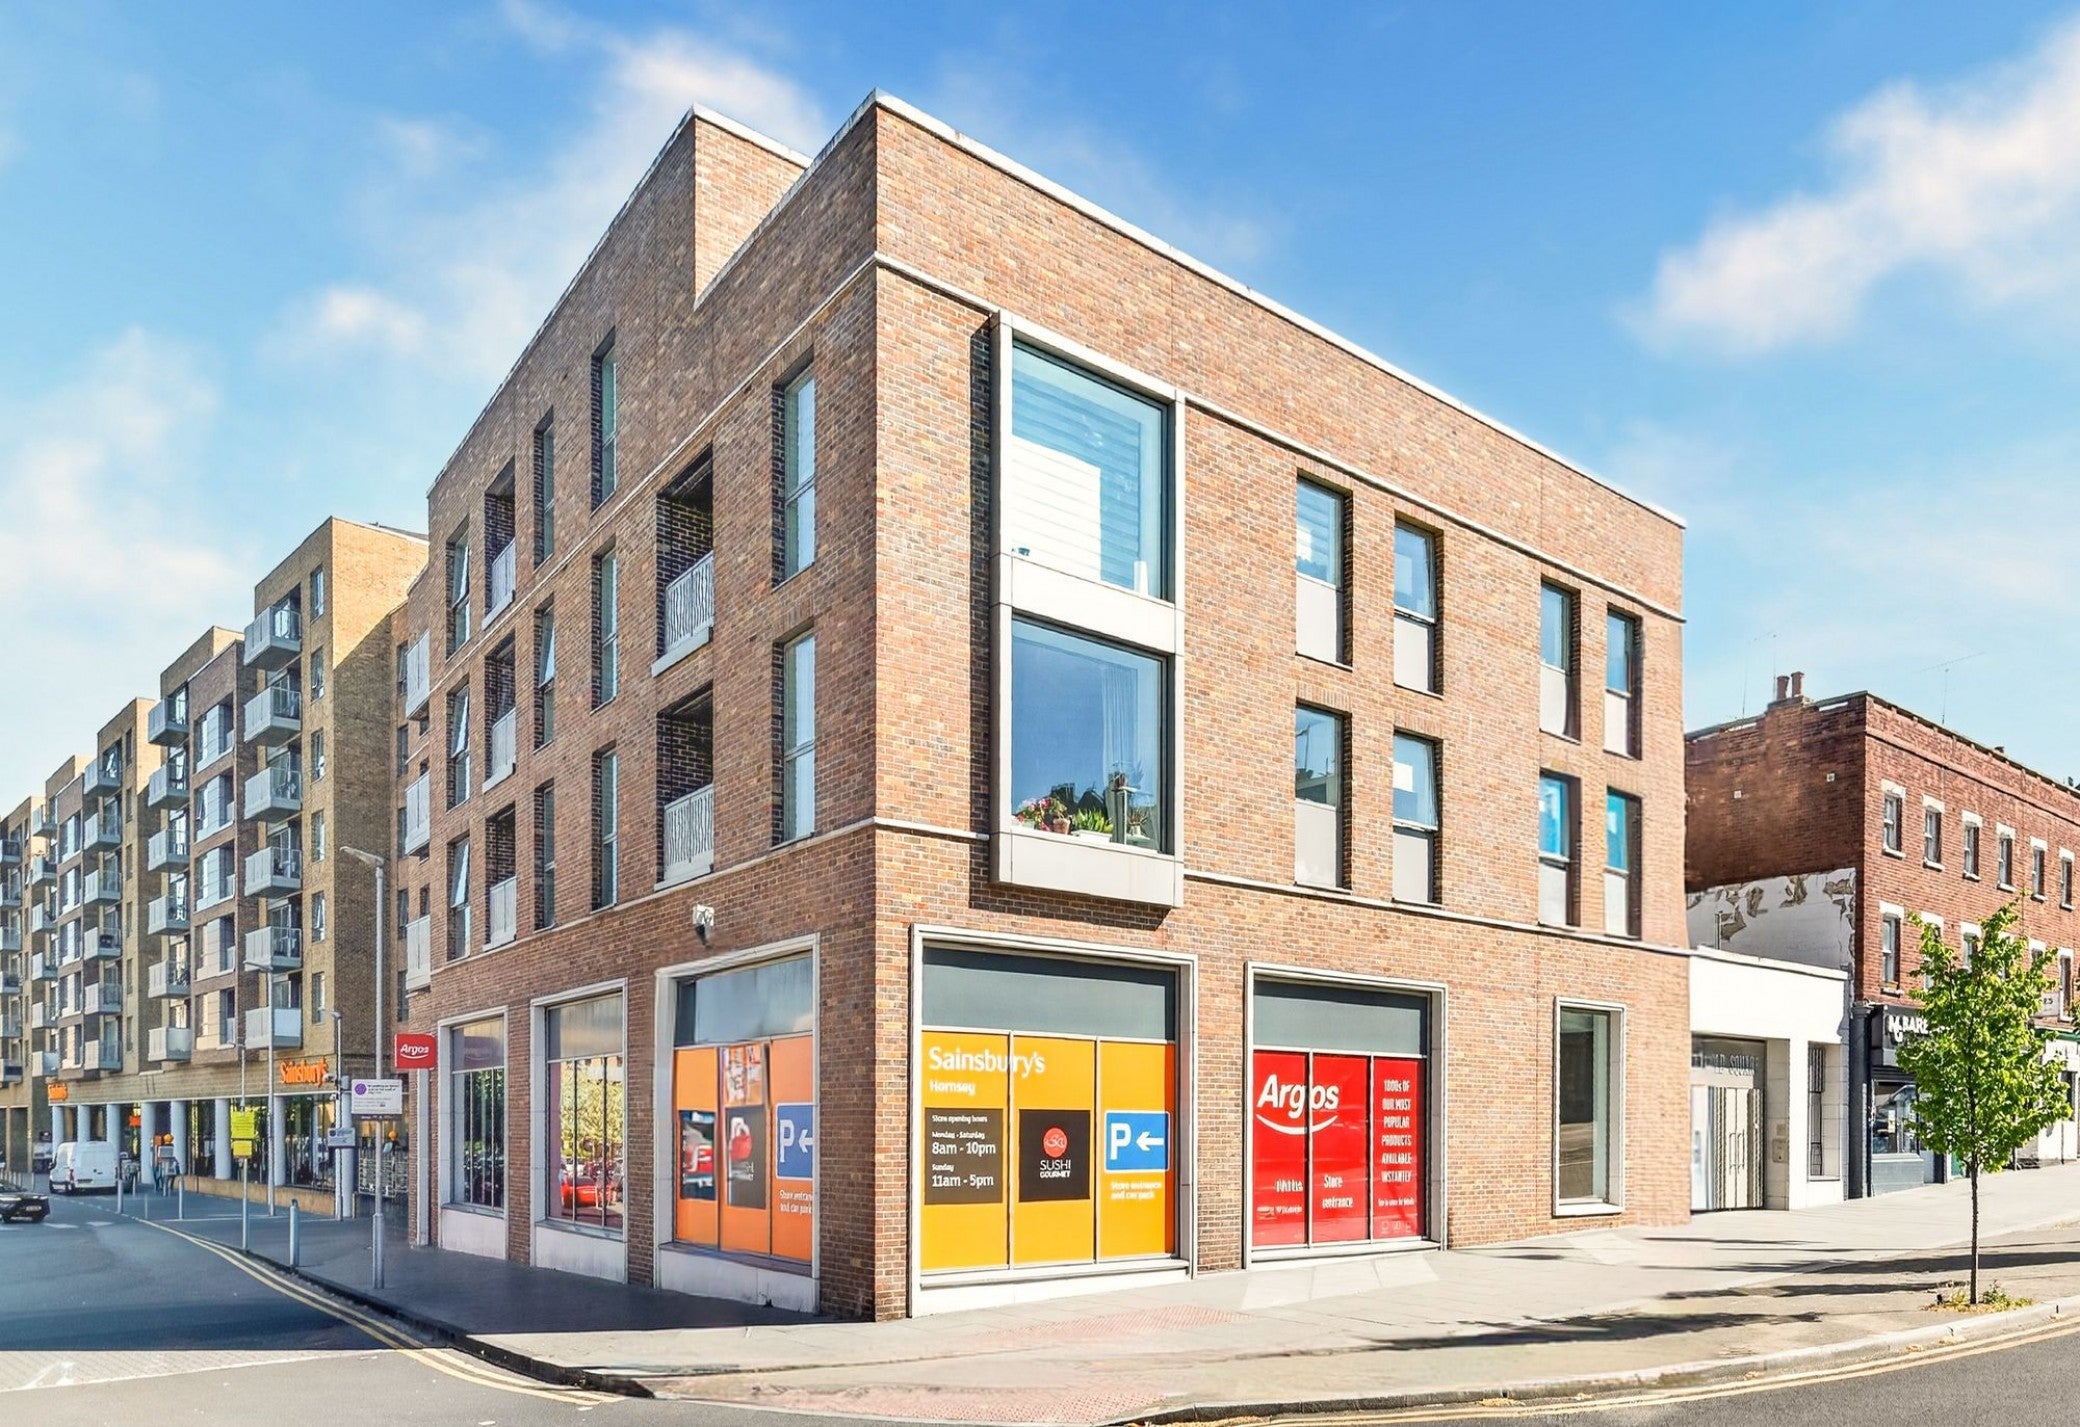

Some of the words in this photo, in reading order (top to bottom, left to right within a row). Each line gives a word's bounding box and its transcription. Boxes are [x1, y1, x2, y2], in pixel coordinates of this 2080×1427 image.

[400, 1043, 429, 1056] Argos
[928, 1046, 1046, 1079] Sainsbury's
[929, 1080, 976, 1096] Hornsey
[1257, 1074, 1340, 1119] Argos
[1110, 1122, 1132, 1160] P
[931, 1141, 958, 1155] 8am
[965, 1141, 996, 1157] 10pm
[931, 1163, 955, 1172] Sunday
[1040, 1160, 1072, 1171] SUSHI
[931, 1174, 961, 1187] 11am
[969, 1174, 994, 1189] 5pm
[1323, 1174, 1343, 1189] Store
[1322, 1197, 1354, 1210] entrance
